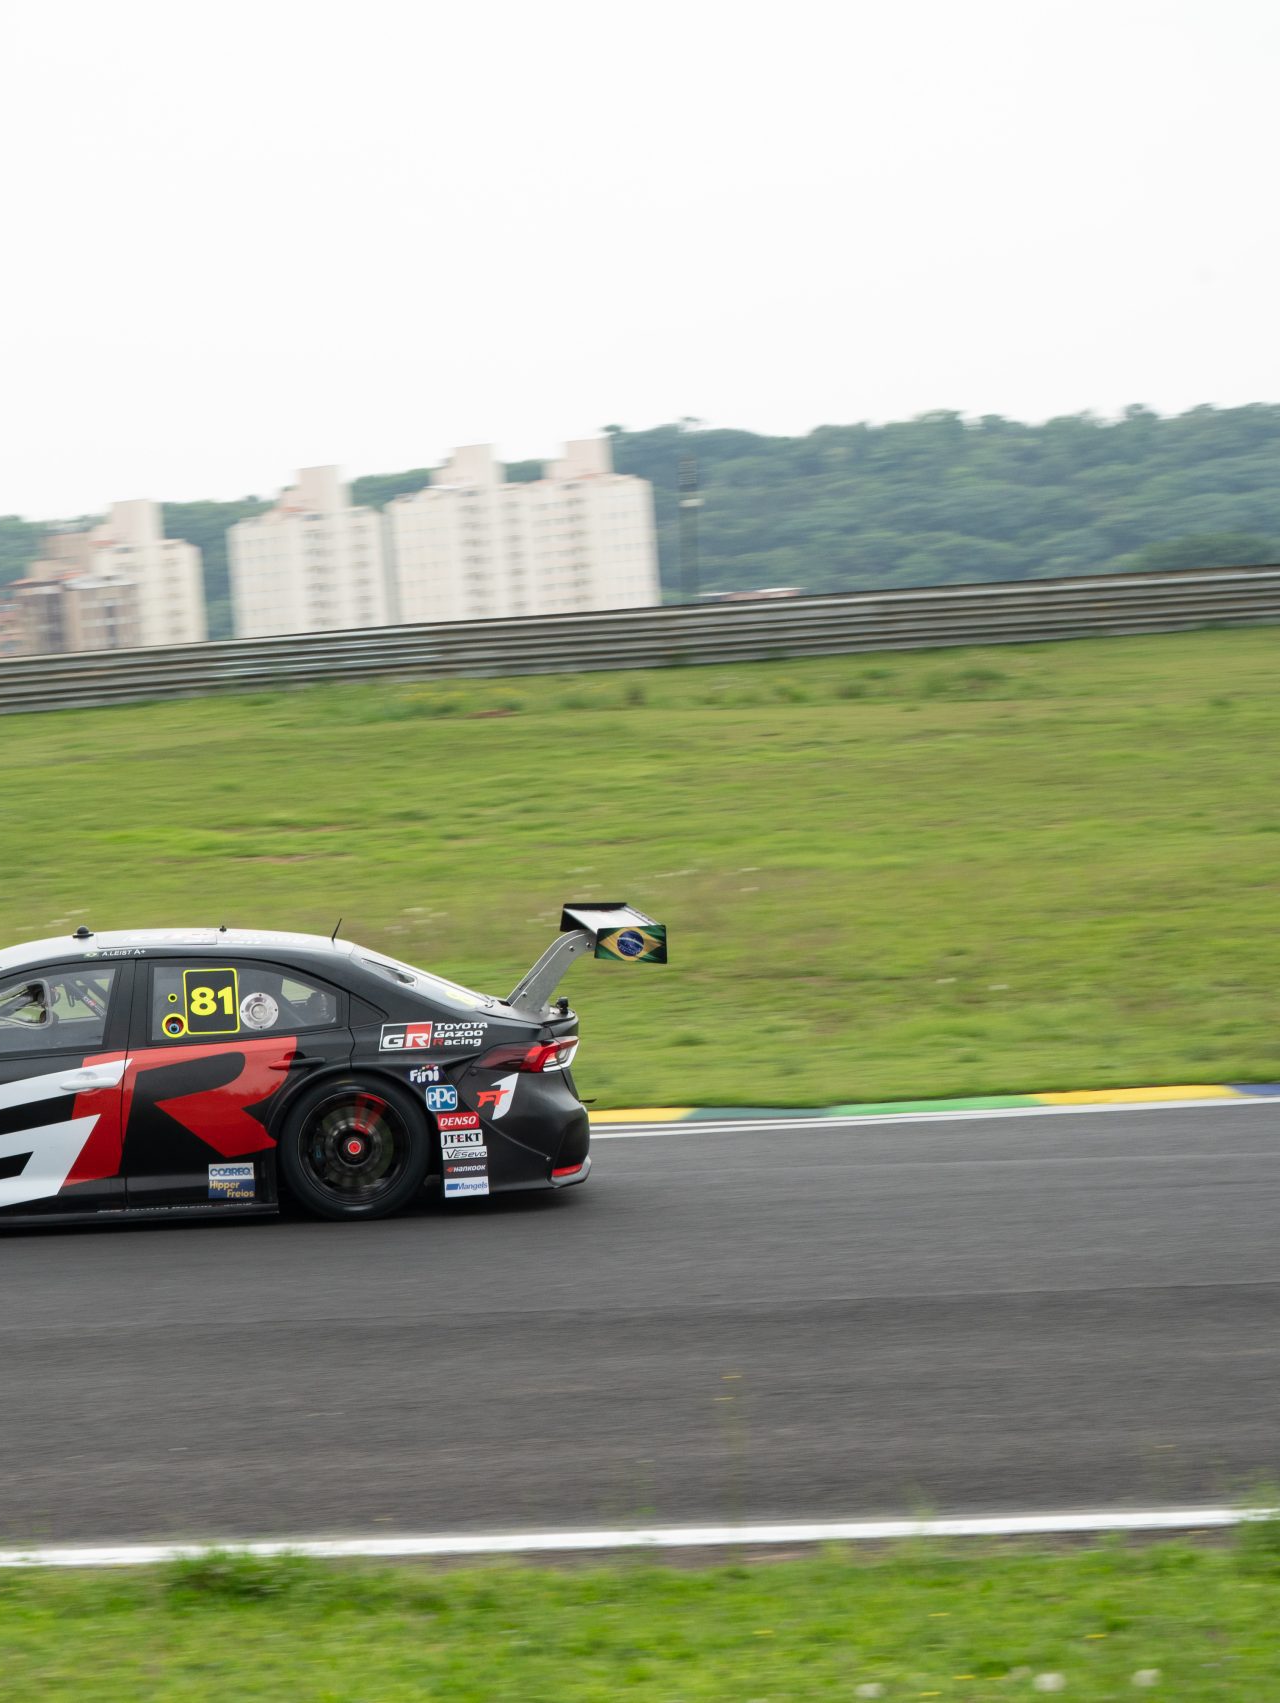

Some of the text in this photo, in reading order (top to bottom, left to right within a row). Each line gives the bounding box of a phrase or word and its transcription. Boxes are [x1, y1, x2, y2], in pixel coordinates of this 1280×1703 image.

[190, 986, 234, 1016] 81
[434, 1022, 488, 1031] TOYOTA
[433, 1030, 484, 1038] GAZOO
[382, 1032, 429, 1048] GR
[432, 1037, 482, 1047] Racing
[440, 1115, 477, 1127] DENSO
[443, 1133, 481, 1146] JTEKT
[209, 1181, 240, 1191] Hipper
[458, 1182, 488, 1190] Mangels
[226, 1189, 255, 1198] Freios
